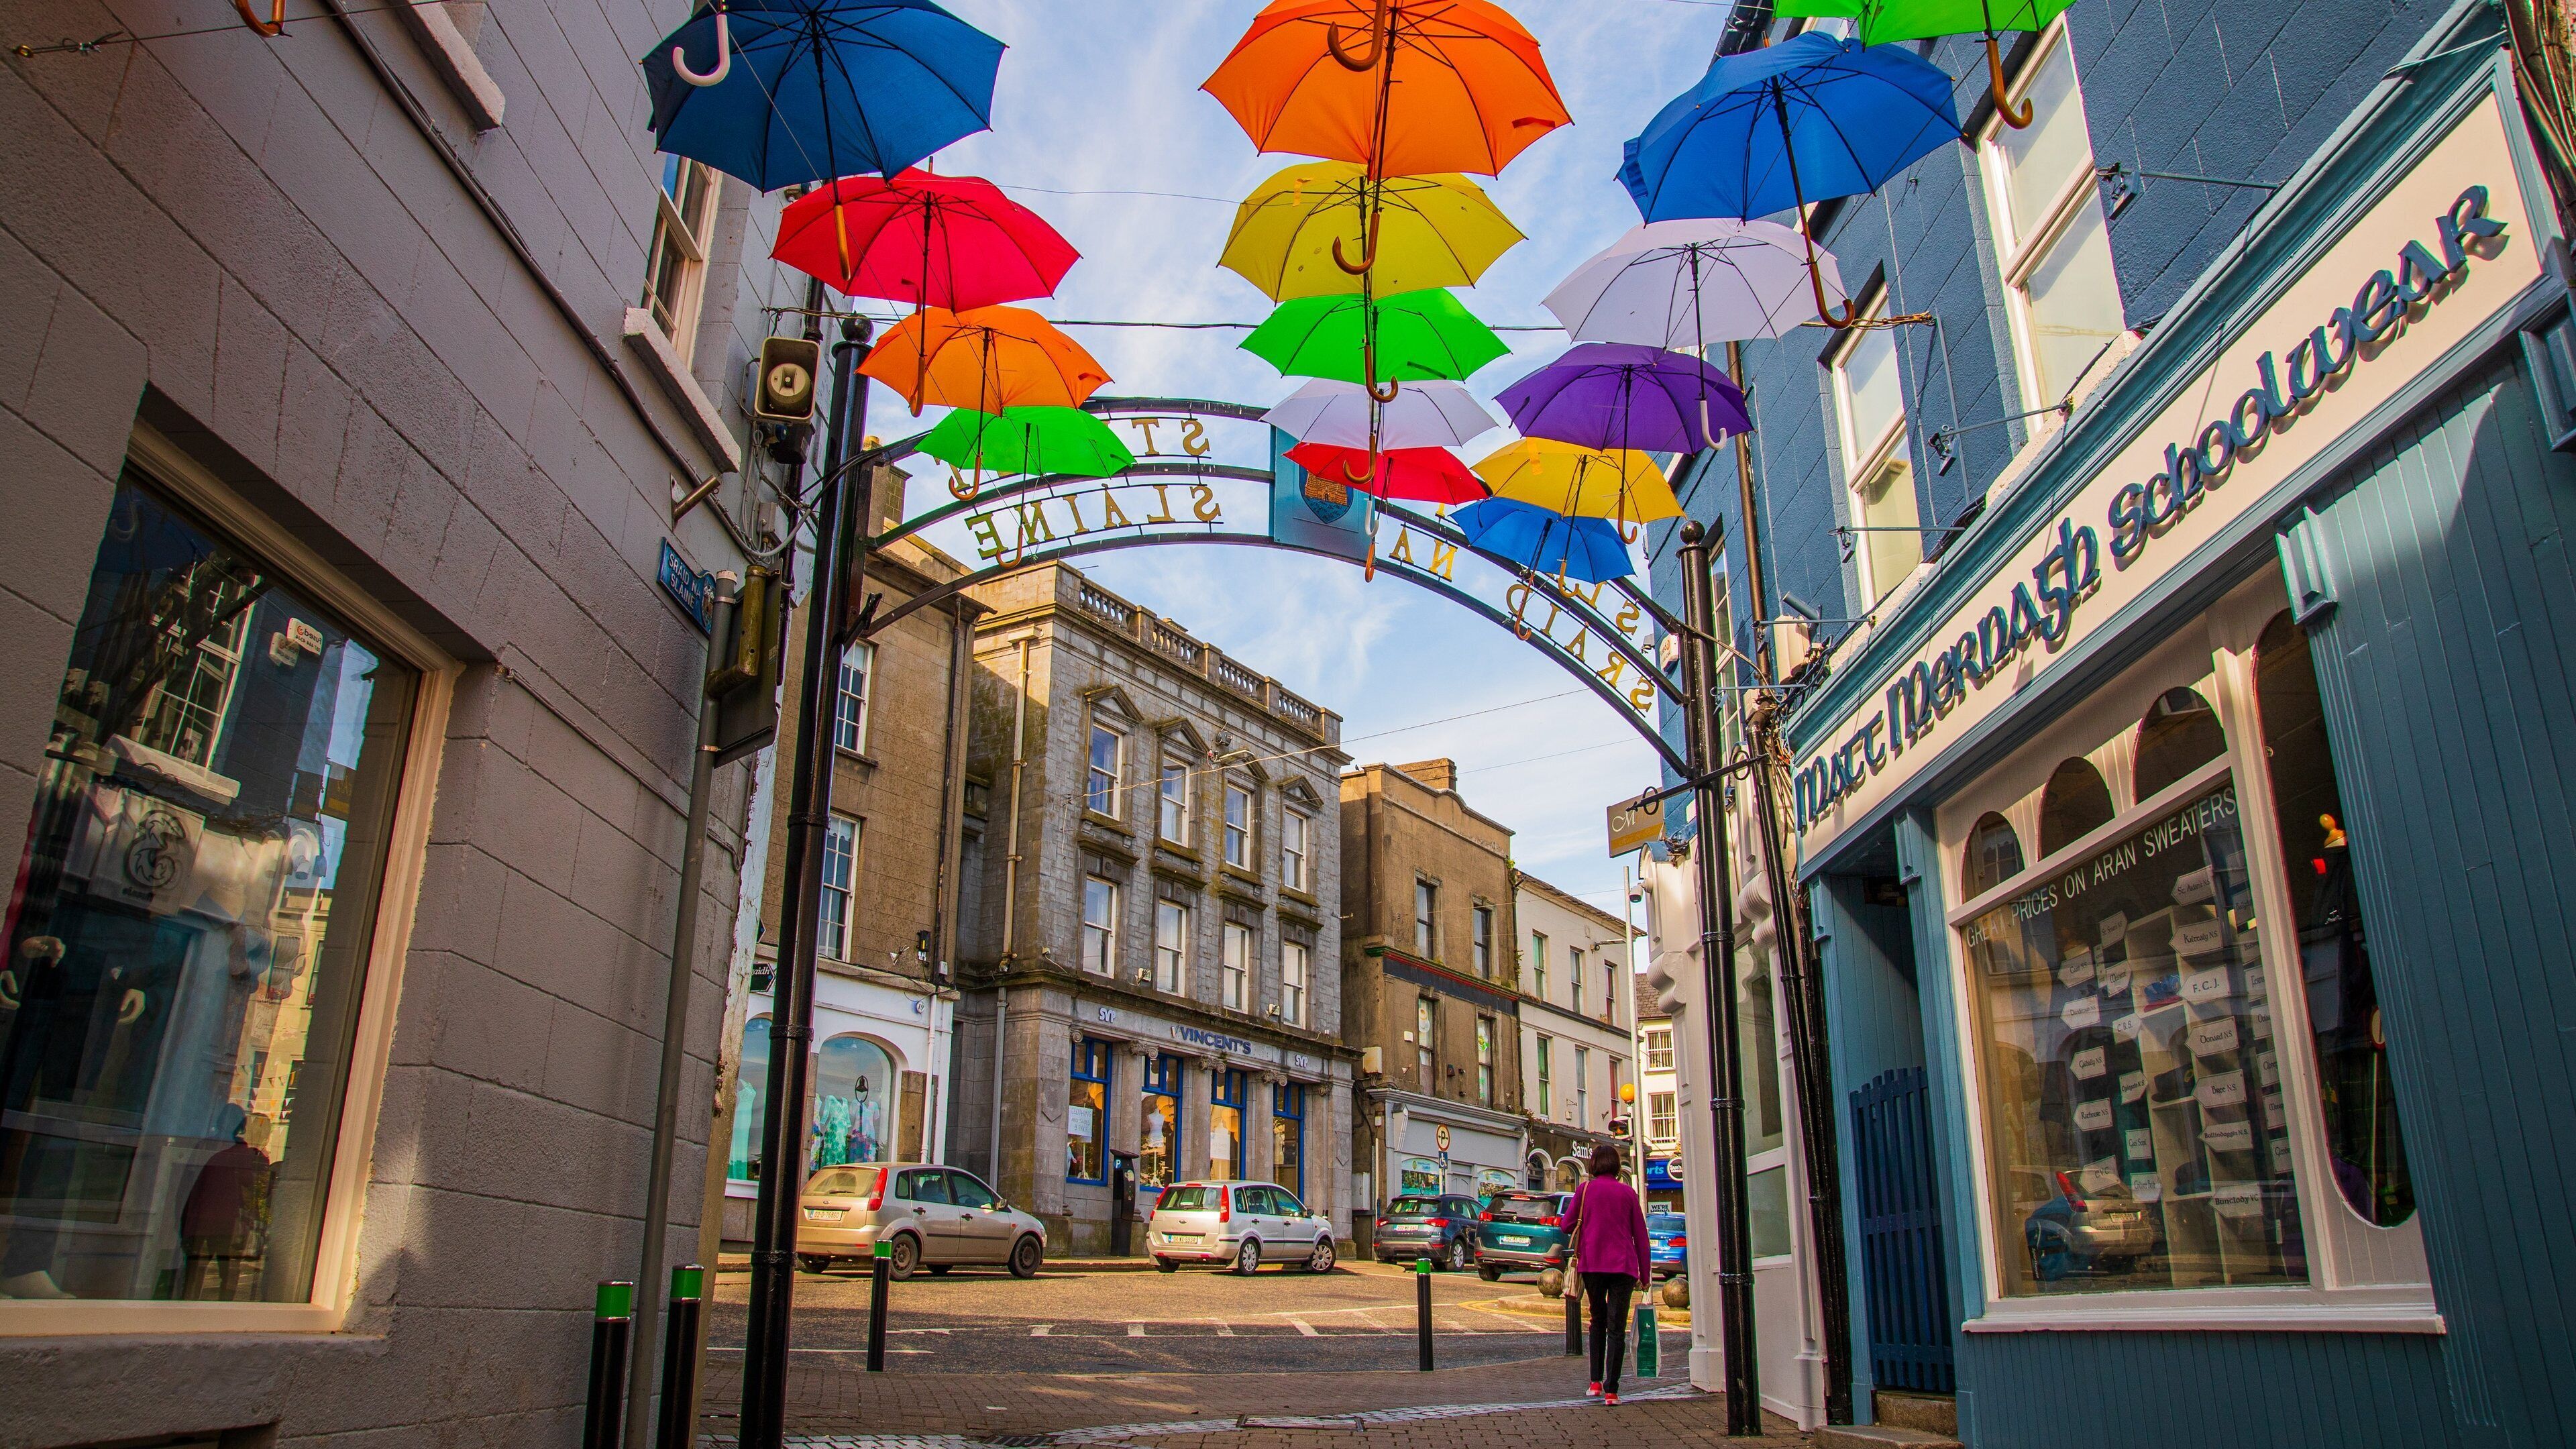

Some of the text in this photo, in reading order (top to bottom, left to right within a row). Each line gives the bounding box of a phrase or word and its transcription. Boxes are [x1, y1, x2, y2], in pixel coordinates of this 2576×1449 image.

[1966, 786, 2237, 948] GREAT PRICES ON ARAN SWEATERS
[1099, 1007, 1117, 1023] SVP
[1181, 1026, 1252, 1055] VINCENT'S
[1295, 1054, 1308, 1068] SVP
[1572, 1140, 1593, 1159] Sam's
[2215, 1197, 2249, 1205] Bunclody
